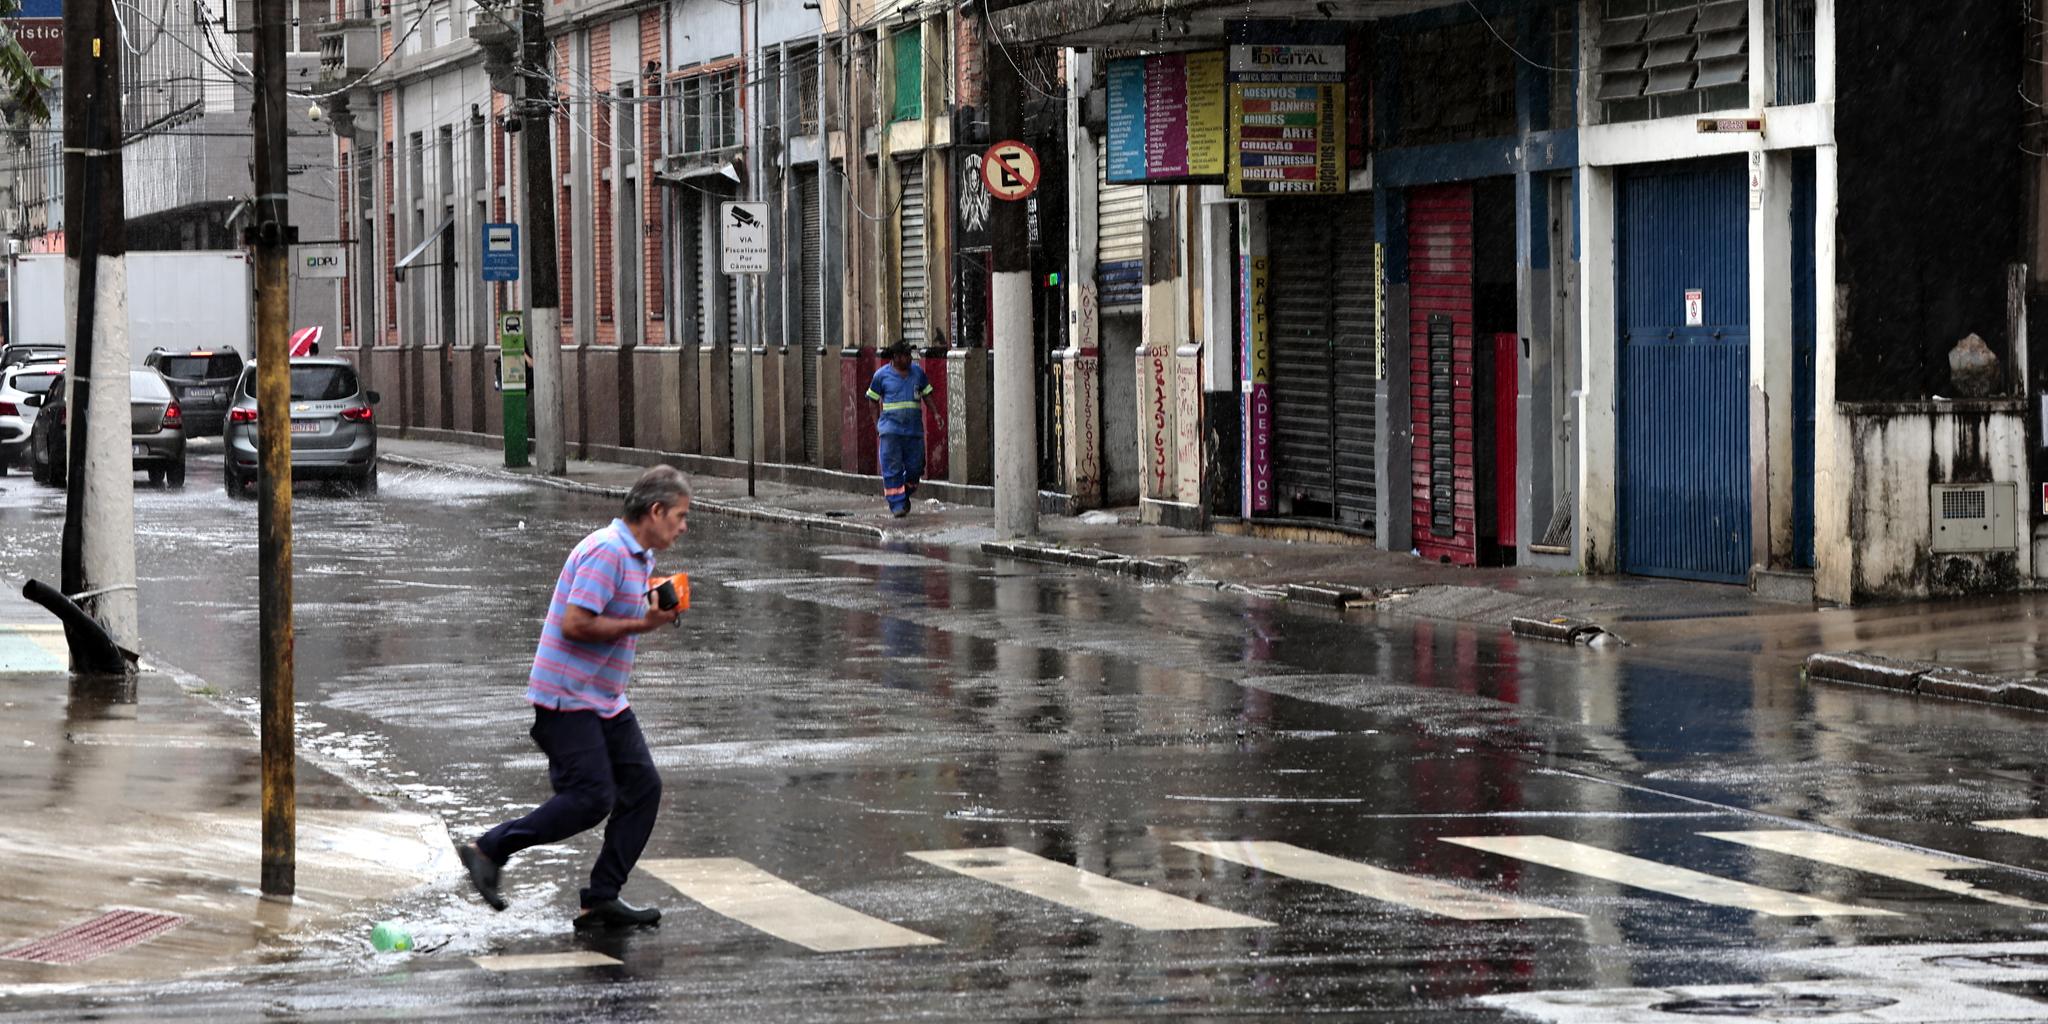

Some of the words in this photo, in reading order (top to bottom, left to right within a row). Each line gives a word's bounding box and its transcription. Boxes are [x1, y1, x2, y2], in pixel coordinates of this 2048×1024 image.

[1257, 53, 1328, 65] DIGITAL
[1244, 87, 1297, 100] ADESIVOS
[1270, 101, 1315, 112] BANNERS
[1244, 114, 1286, 126] BRINDES
[1283, 128, 1314, 139] ARTE
[1241, 140, 1294, 153] CRIAÇÃO
[1263, 154, 1314, 165] IMPRESSÃO
[1000, 152, 1022, 188] E
[1243, 168, 1286, 179] DIGITAL
[1319, 145, 1339, 193] SOLUÇÕES
[1268, 181, 1315, 192] OFFSET
[317, 256, 338, 267] DPU
[1151, 345, 1169, 357] 013
[1257, 388, 1268, 506] ADESIVOS
